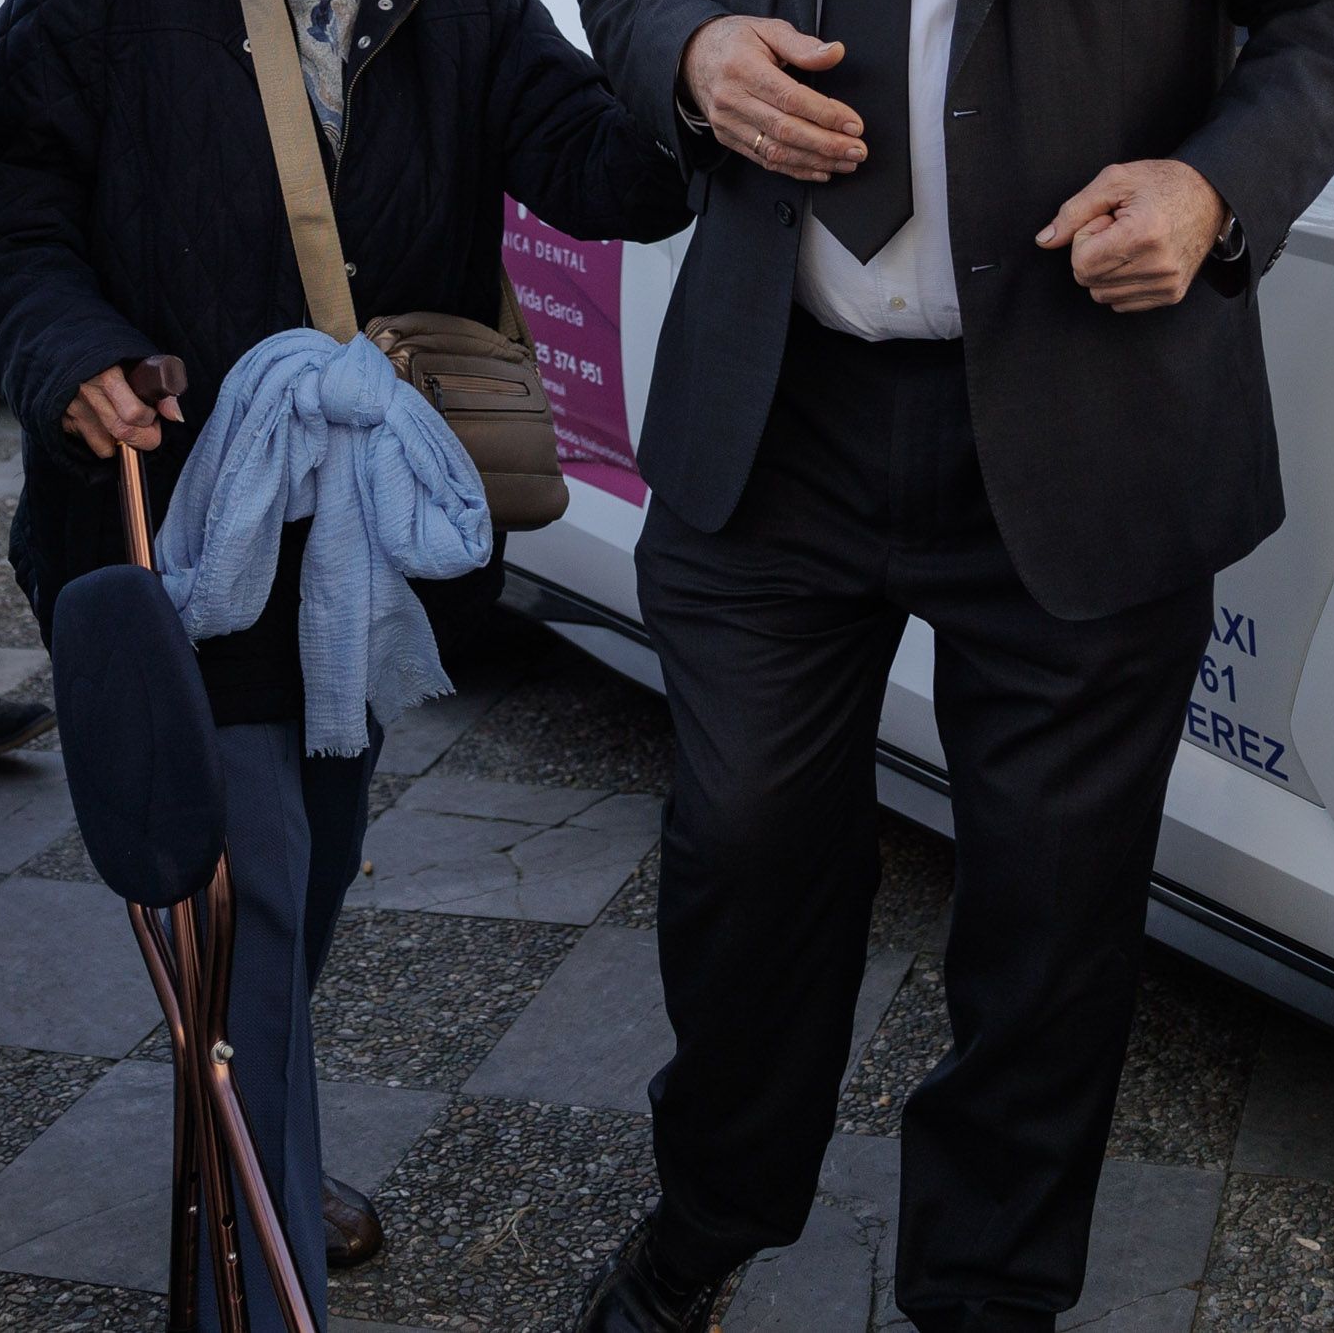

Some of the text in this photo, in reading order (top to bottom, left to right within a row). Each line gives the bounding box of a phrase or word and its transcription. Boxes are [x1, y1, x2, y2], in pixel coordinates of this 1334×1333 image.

[535, 240, 587, 273] DENTAL
[515, 283, 584, 327] Vida García
[553, 349, 576, 374] 374
[580, 360, 603, 385] 951
[1199, 654, 1236, 703] 61
[1187, 700, 1289, 782] EREZ
